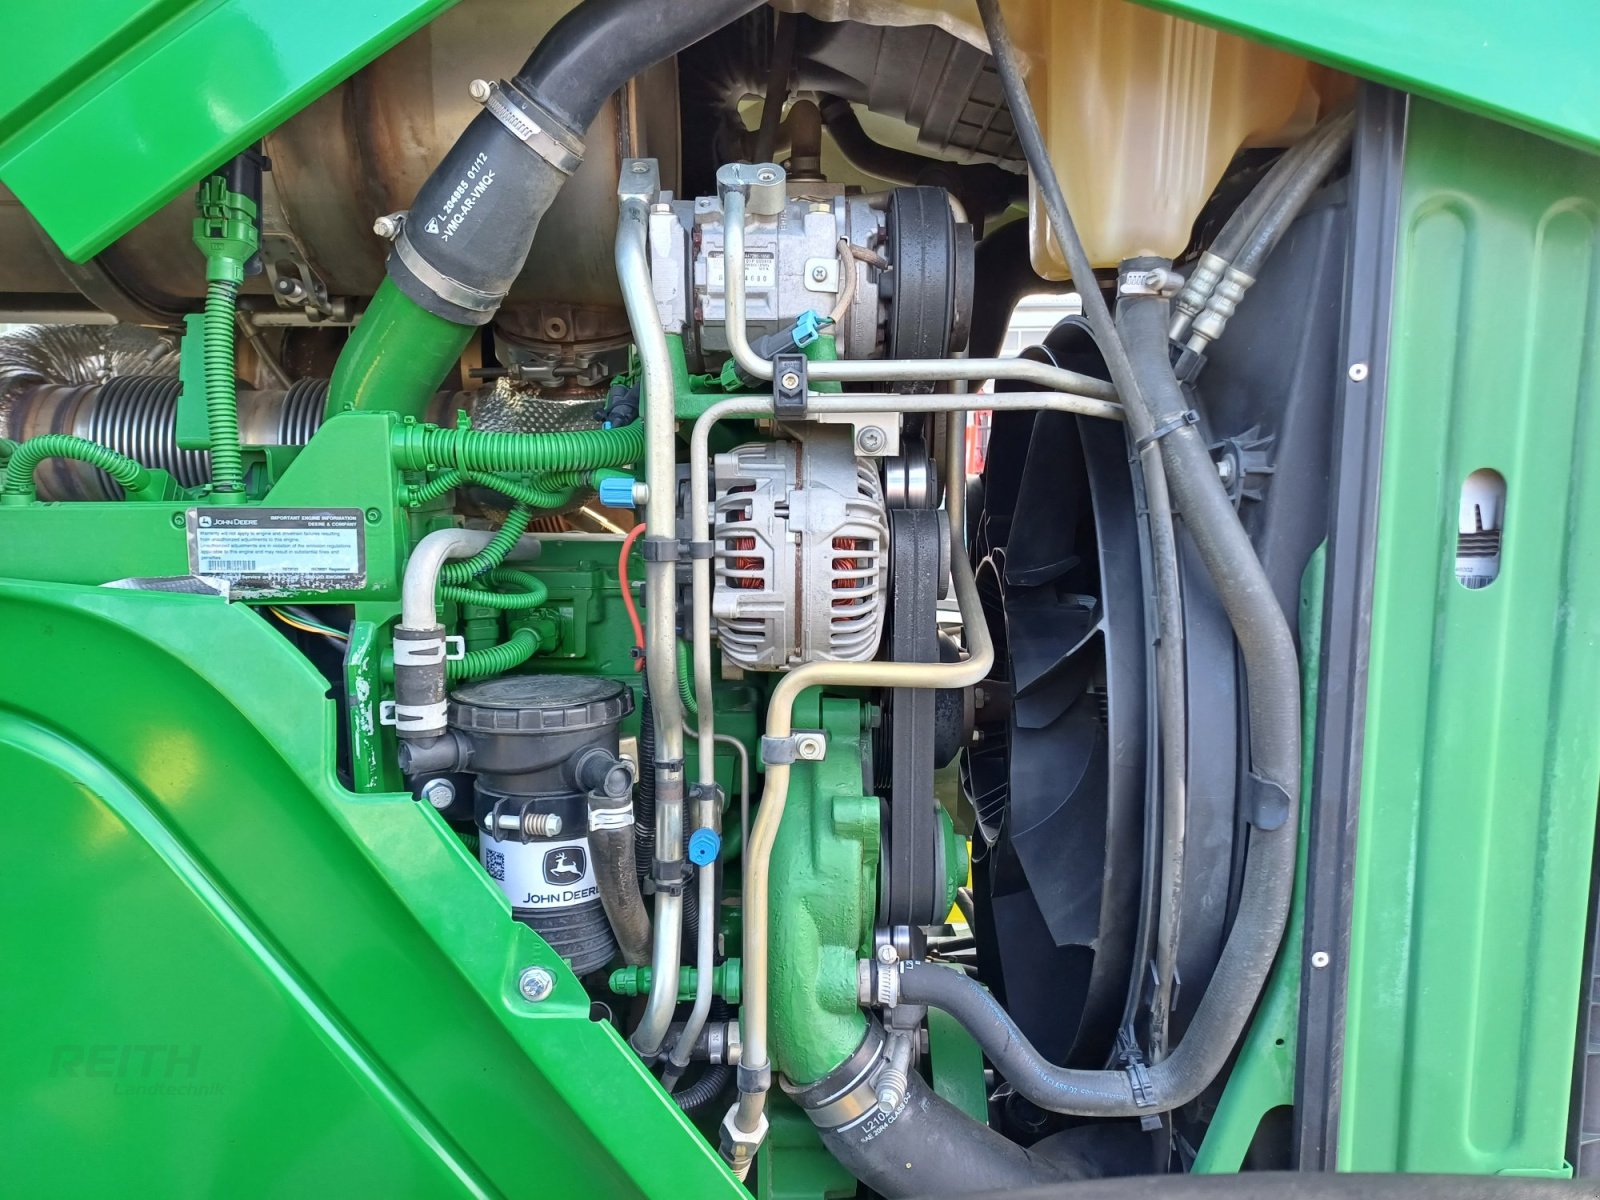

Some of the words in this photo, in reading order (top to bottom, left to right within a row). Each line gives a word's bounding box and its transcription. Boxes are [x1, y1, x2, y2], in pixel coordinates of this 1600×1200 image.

[467, 152, 488, 180] 01/12
[213, 518, 233, 526] JOHN
[233, 518, 258, 526] DEERE
[523, 892, 560, 904] JOHN
[888, 1103, 906, 1124] CLASS
